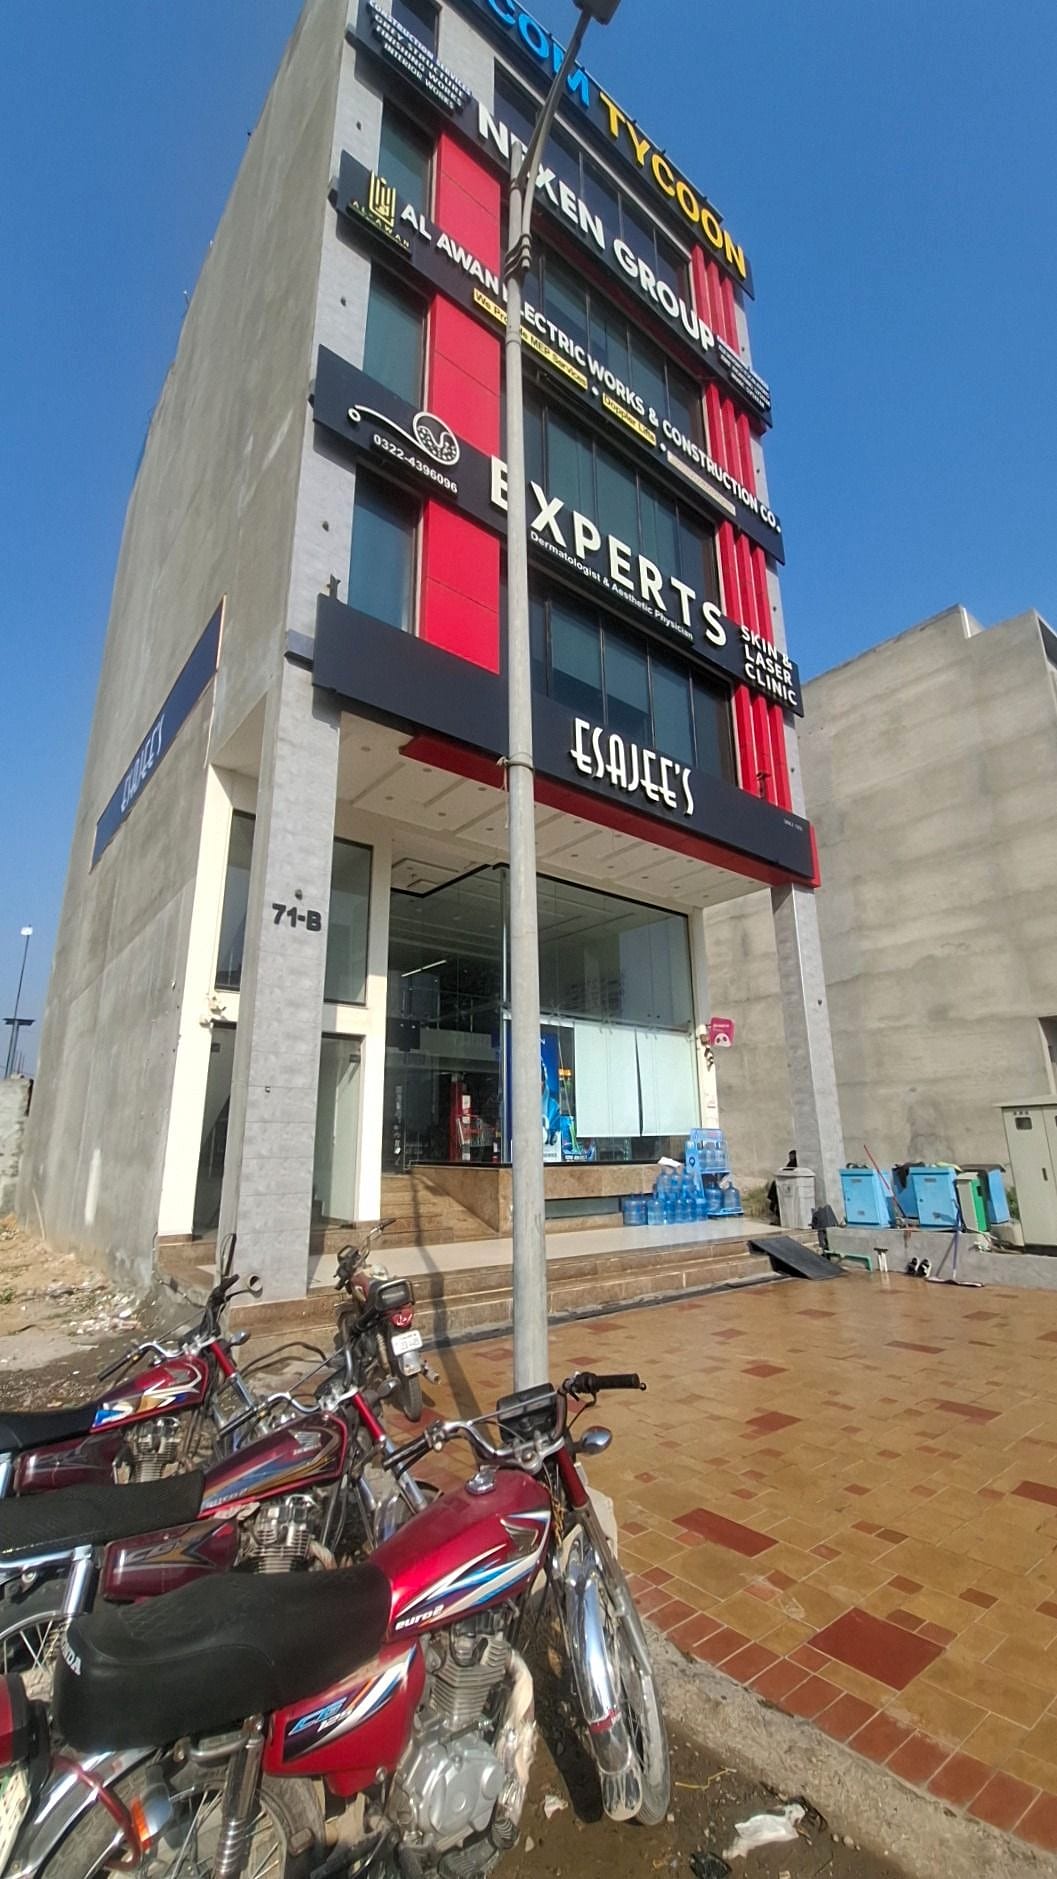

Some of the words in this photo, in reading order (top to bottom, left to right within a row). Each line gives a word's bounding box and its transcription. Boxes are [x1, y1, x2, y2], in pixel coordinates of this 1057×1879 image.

[376, 25, 425, 72] FINISHING
[428, 71, 462, 107] WORKS
[600, 91, 747, 279] TYCOON
[475, 290, 491, 310] We
[613, 238, 715, 352] GROUP
[400, 203, 432, 241] AL
[436, 233, 499, 296] AWAN
[502, 282, 586, 367] ECTRIC
[587, 353, 645, 416] WORKS
[648, 407, 659, 428] &
[662, 419, 758, 513] CONSTRUCTION
[759, 504, 782, 534] CO.
[373, 434, 458, 494] 0322-4396096
[491, 454, 727, 648] EXPERTS
[530, 531, 601, 583] Dermatologist
[602, 577, 610, 587] &
[611, 584, 653, 615] Aesthetic
[654, 609, 694, 641] Physician
[741, 624, 777, 661] SKIN
[782, 653, 793, 670] &
[744, 643, 793, 687] LASER
[744, 662, 798, 706] CLINIC
[570, 717, 695, 817] ESAJEE'S
[272, 903, 322, 932] 71-B
[395, 1604, 444, 1631] euro2
